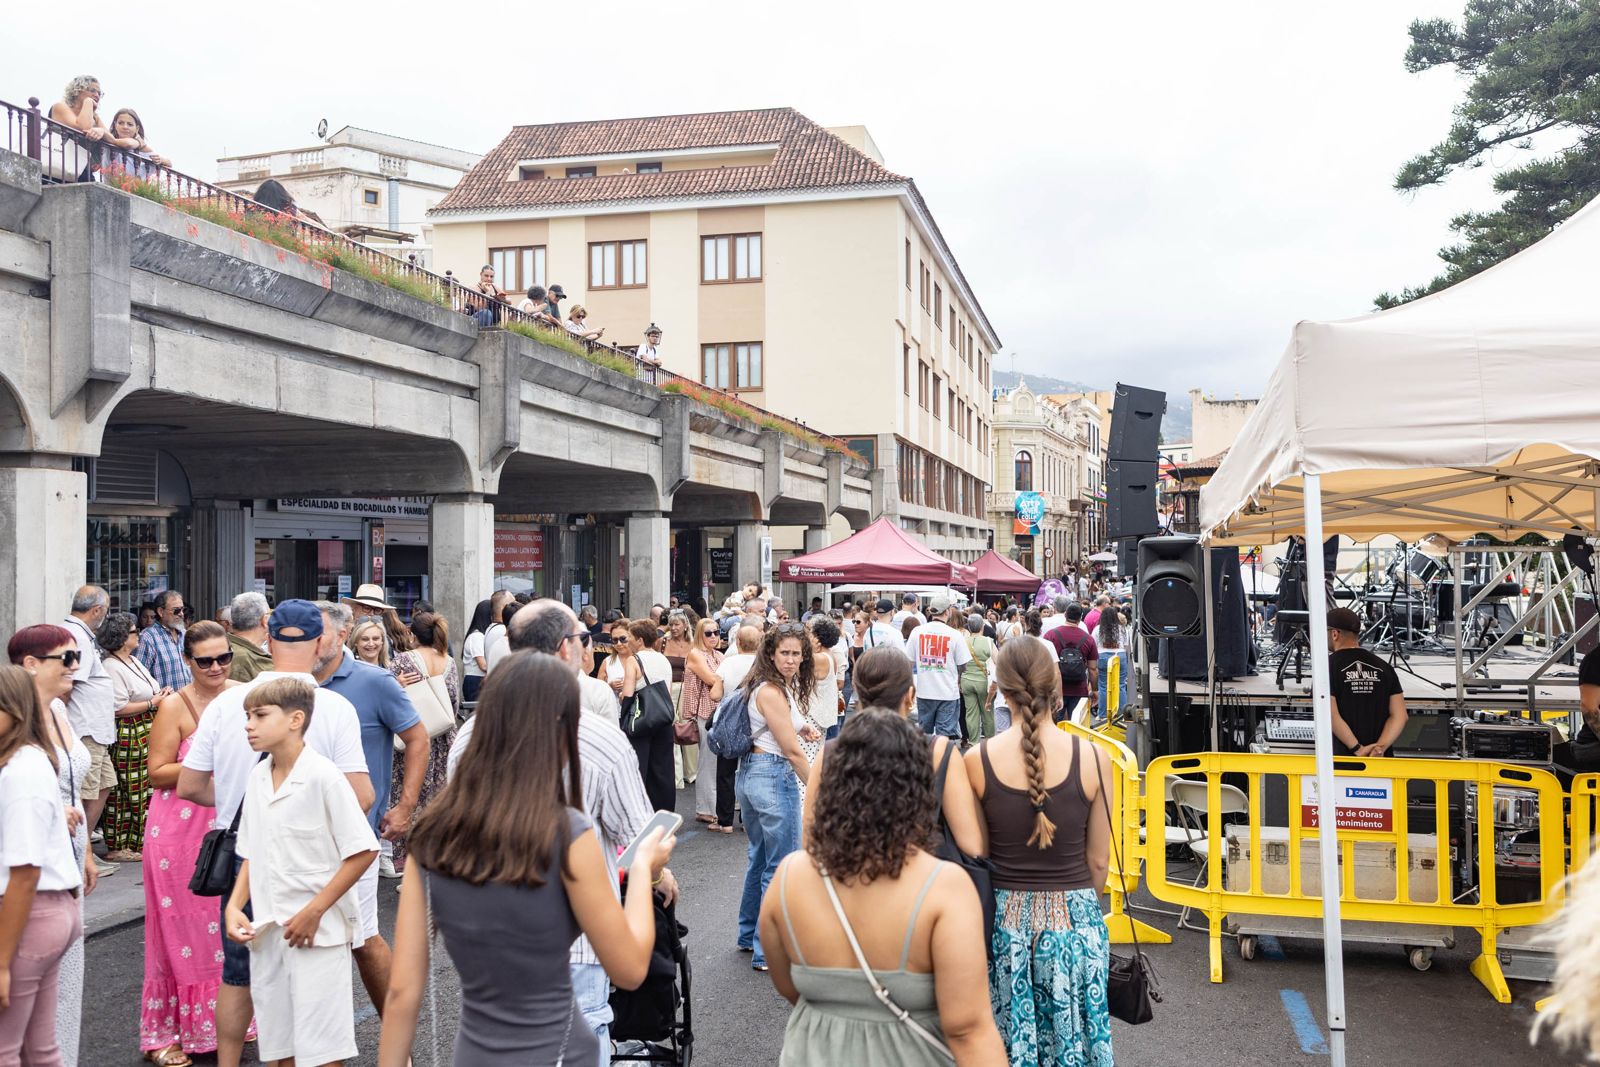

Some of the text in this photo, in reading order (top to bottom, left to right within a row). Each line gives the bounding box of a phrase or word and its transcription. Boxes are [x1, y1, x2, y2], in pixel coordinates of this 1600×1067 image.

[281, 499, 339, 510] ESPECIALIDAD
[341, 502, 351, 511] EN
[353, 503, 397, 514] BOCADILLOS
[397, 506, 403, 515] Y
[1311, 808, 1344, 817] Seio
[1358, 810, 1384, 819] Obras
[1319, 820, 1383, 828] tenimiento
